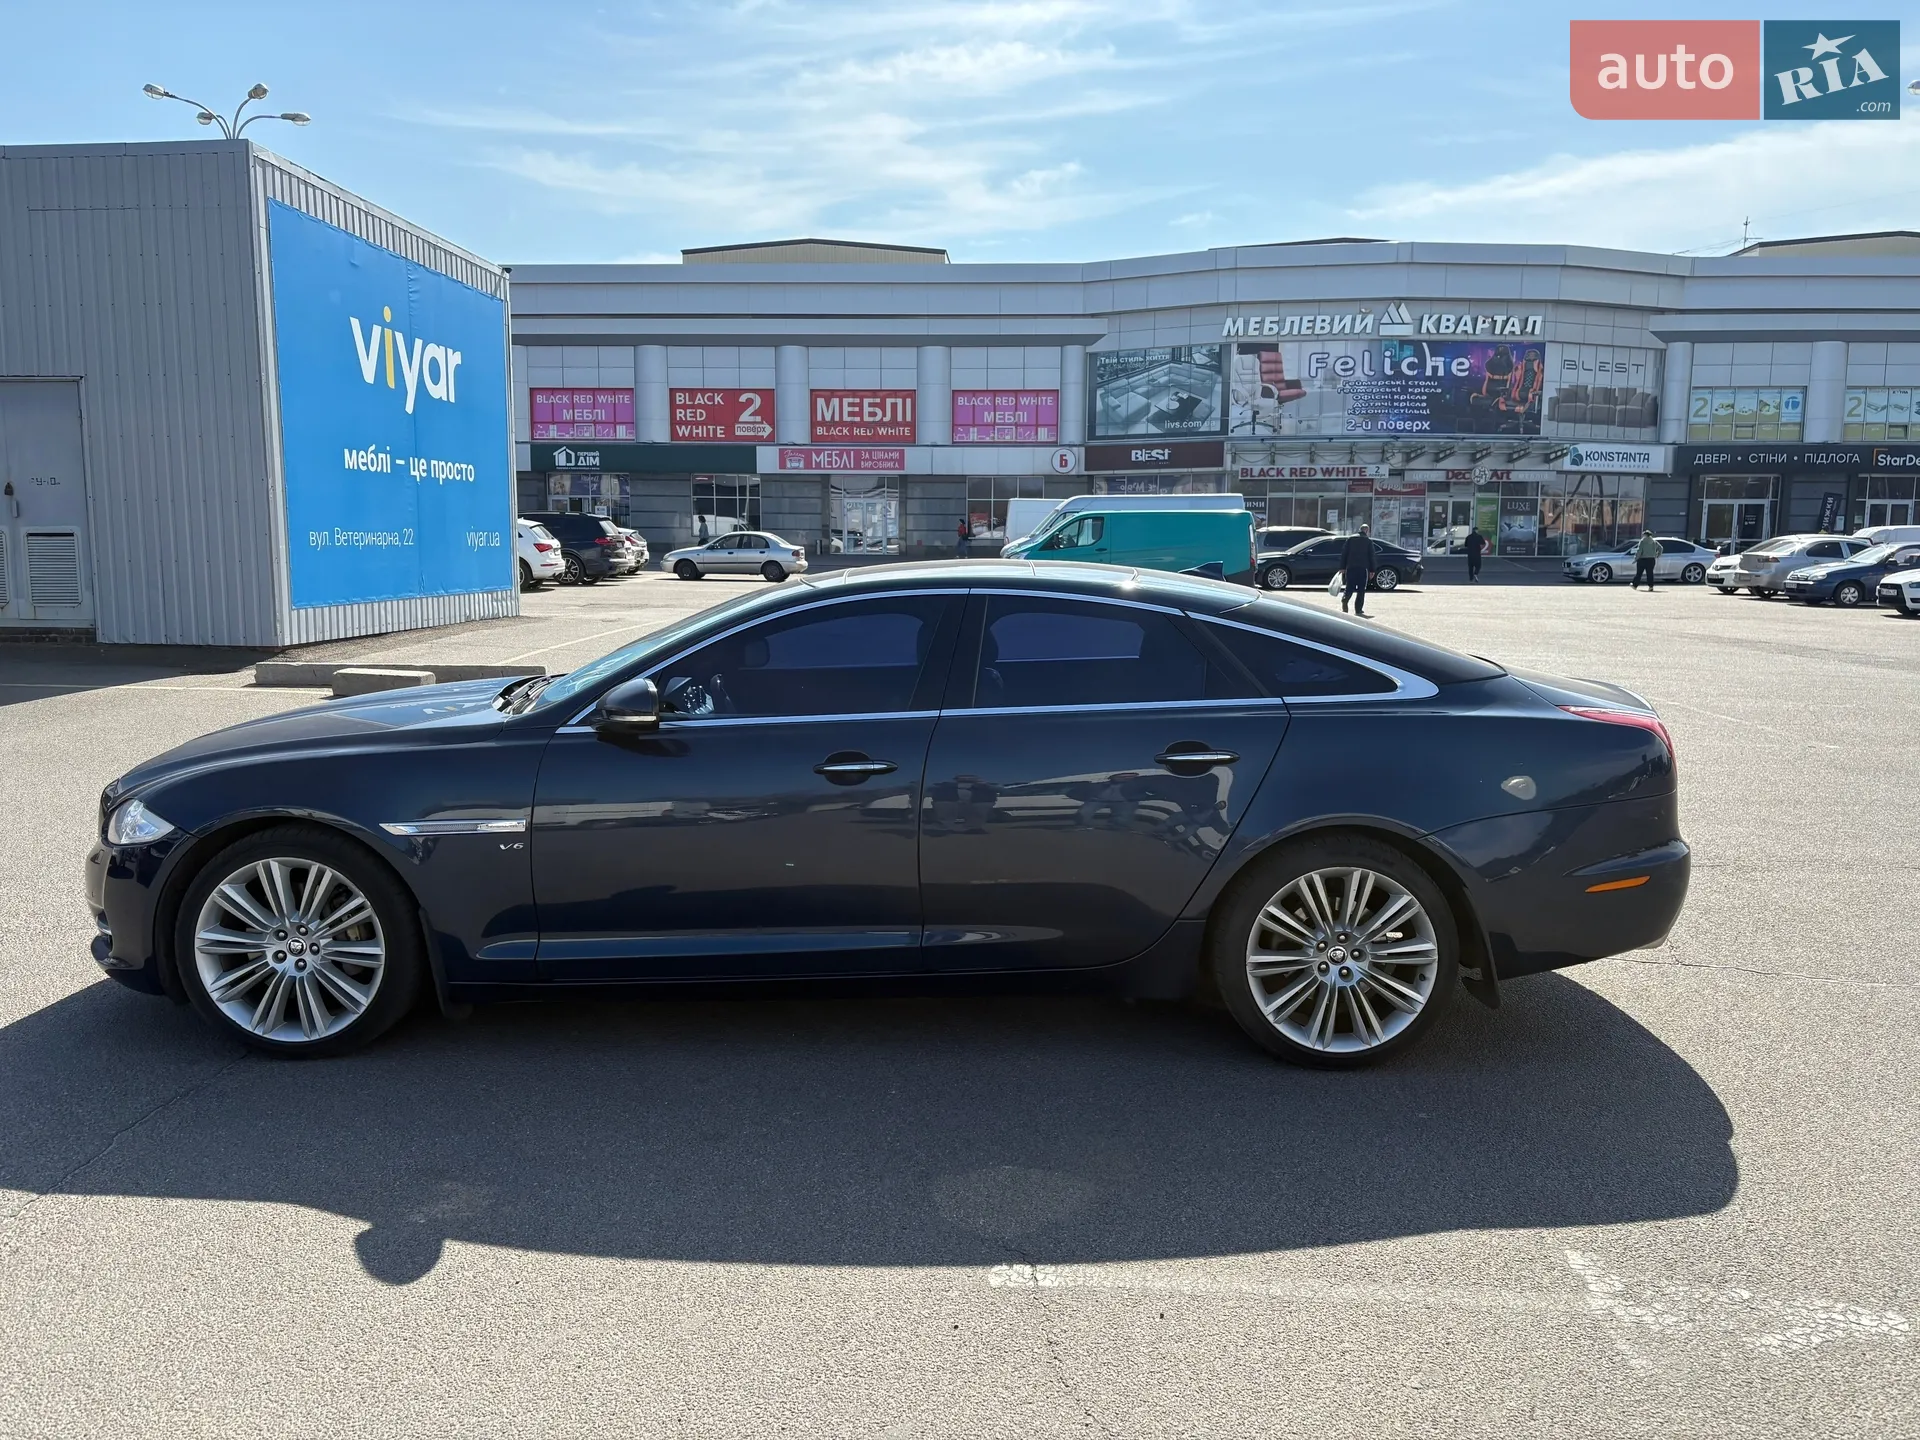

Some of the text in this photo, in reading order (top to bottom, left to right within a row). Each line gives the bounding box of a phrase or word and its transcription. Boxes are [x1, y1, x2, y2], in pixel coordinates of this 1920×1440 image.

[1221, 313, 1544, 337] МЕБЛЕВИЙ КВАРТАЛ
[349, 305, 462, 415] viyar
[1120, 355, 1144, 364] стиль
[1308, 341, 1471, 379] Feliche
[1562, 359, 1645, 375] BLEST
[536, 394, 631, 404] BLACK RED WHITE
[677, 392, 724, 405] BLACK
[957, 396, 1054, 406] BLACK RED WHITE
[738, 392, 762, 422] 2
[816, 397, 912, 422] МЕБЛІ
[1692, 396, 1709, 418] 2
[1846, 396, 1862, 418] 2
[563, 408, 605, 421] МЕБЛІ
[677, 408, 706, 422] RED
[983, 411, 1027, 423] МЕБЛІ
[677, 425, 726, 438] WHITE
[736, 424, 767, 435] поверх
[816, 426, 911, 436] BLACK RED WHITE
[1377, 420, 1431, 432] поверх
[811, 450, 854, 469] МЕБЛІ
[860, 450, 900, 461] ЗА ЦІНАМИ
[1059, 453, 1069, 469] Б
[1584, 450, 1650, 464] KONSTANTA
[1693, 453, 1861, 466] ДВЕРІ СТІНИ ПІДЛОГА
[344, 444, 391, 474] меблі
[409, 456, 428, 482] це
[430, 459, 475, 485] просто
[860, 460, 900, 469] ВИРОБНИКА
[1374, 465, 1381, 474] 2
[1240, 466, 1368, 478] BLACK RED WHITE
[309, 527, 414, 551] вул. Ветеринарна, 22
[466, 526, 500, 552] viyar.ua
[499, 842, 525, 850] V6
